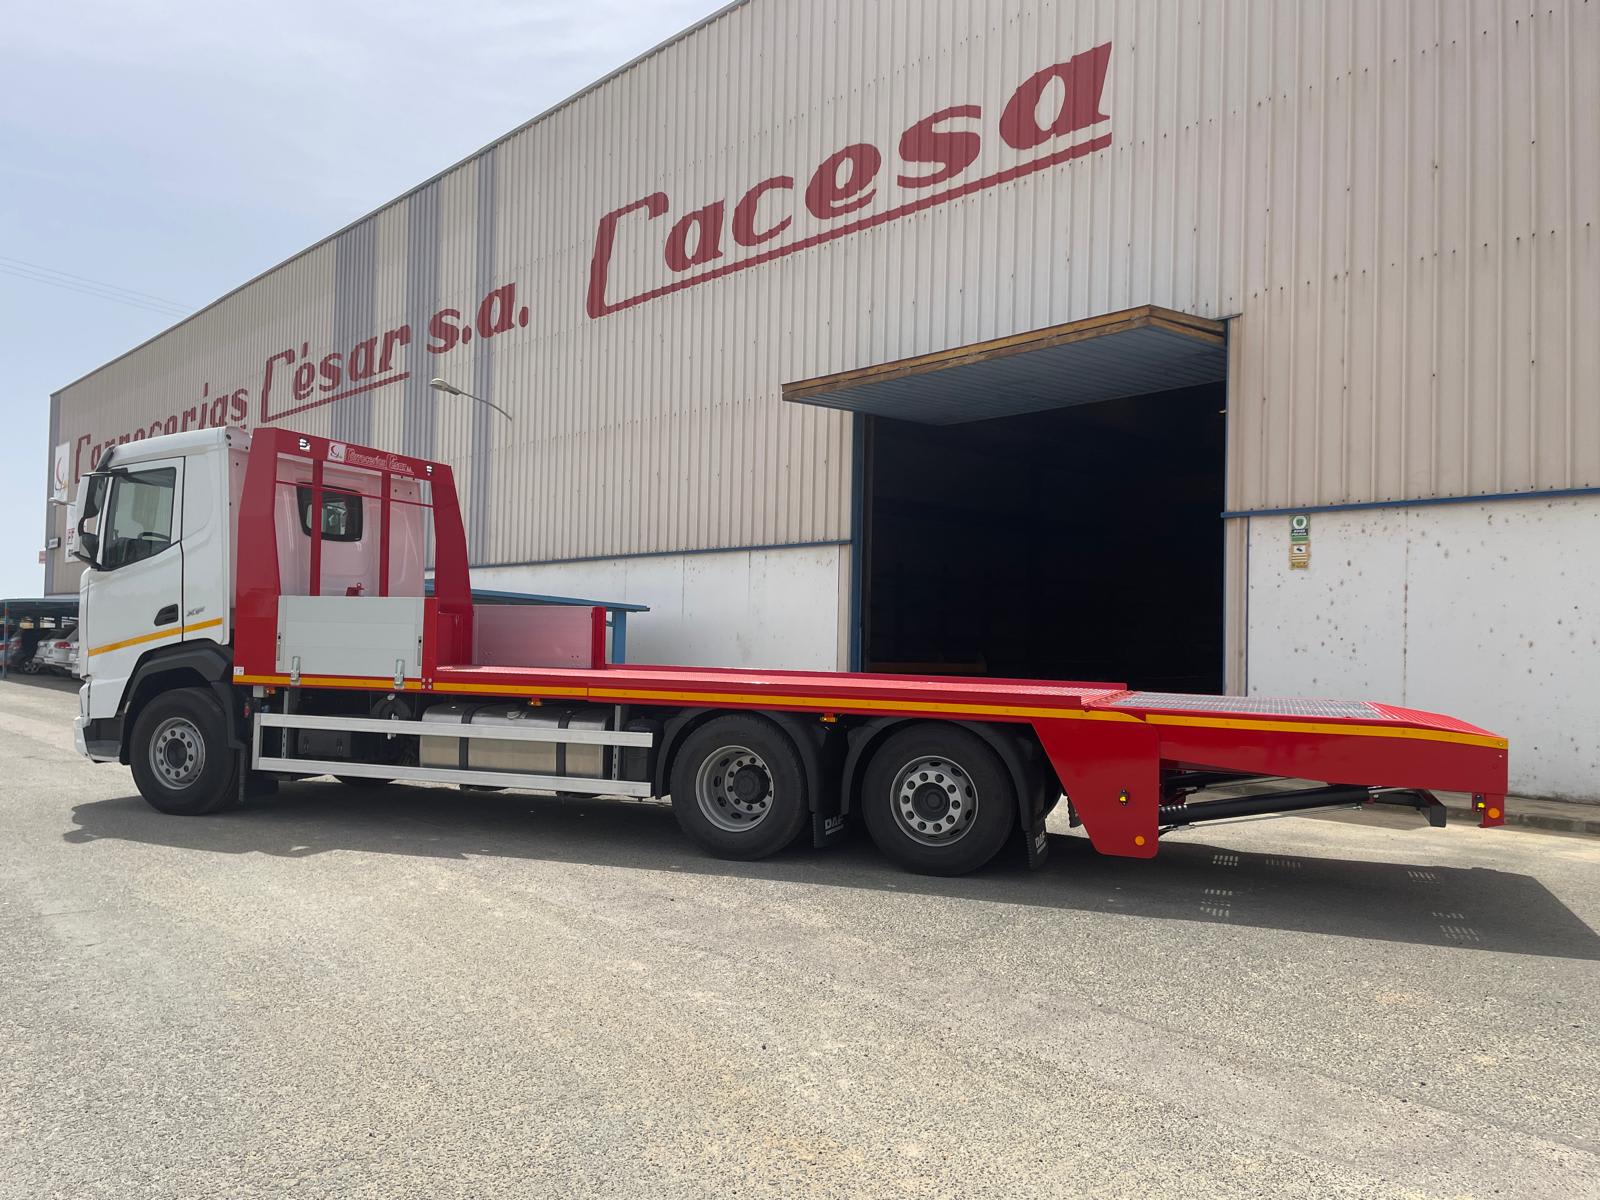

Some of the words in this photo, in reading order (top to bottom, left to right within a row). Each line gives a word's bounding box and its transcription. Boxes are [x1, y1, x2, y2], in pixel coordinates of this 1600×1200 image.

[586, 42, 1112, 320] Cacesa
[260, 324, 411, 424] César
[426, 282, 529, 355] s.a.
[824, 815, 844, 830] DAF
[1035, 830, 1046, 849] DAF
